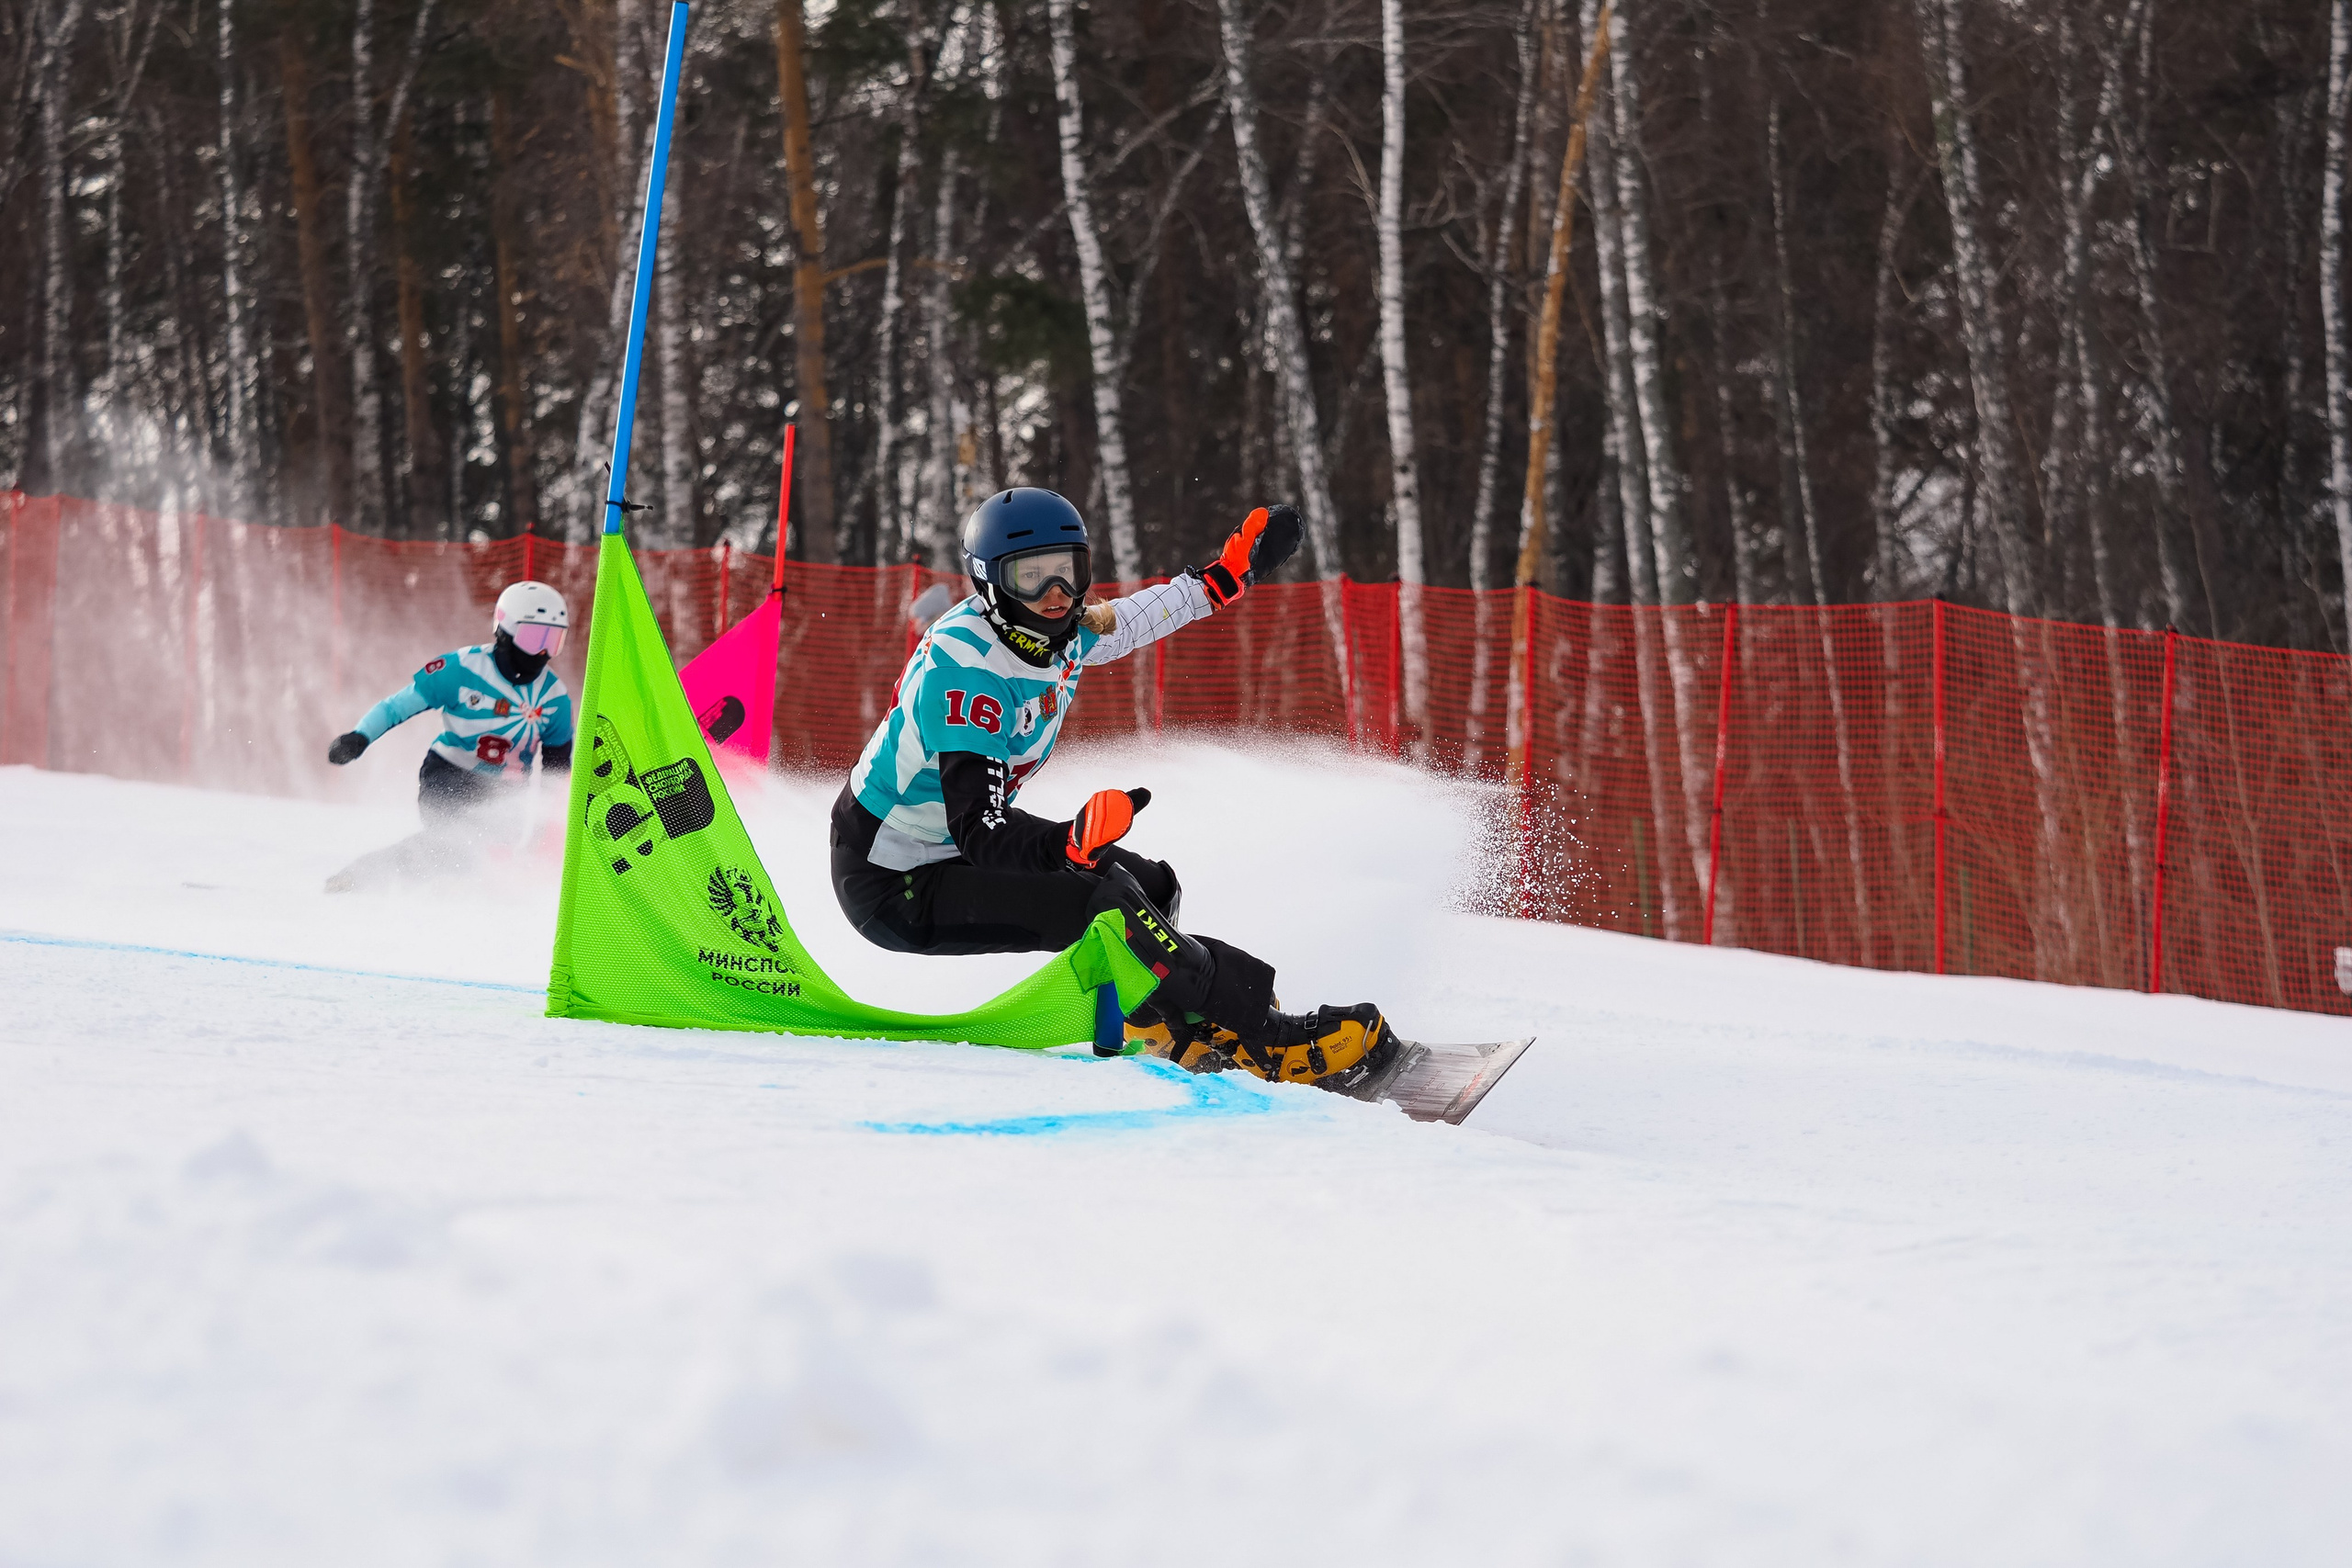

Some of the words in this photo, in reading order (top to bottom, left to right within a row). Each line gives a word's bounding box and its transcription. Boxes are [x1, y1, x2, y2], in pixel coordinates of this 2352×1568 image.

[944, 689, 1003, 736] 16
[645, 760, 689, 784] ФЕДЕРАЦИЯ
[649, 768, 694, 793] СНОУБОРДА
[652, 784, 687, 802] РОССИИ
[1136, 908, 1178, 953] LEKI
[698, 949, 796, 975] МИНСПО
[712, 972, 800, 997] РОССИИ
